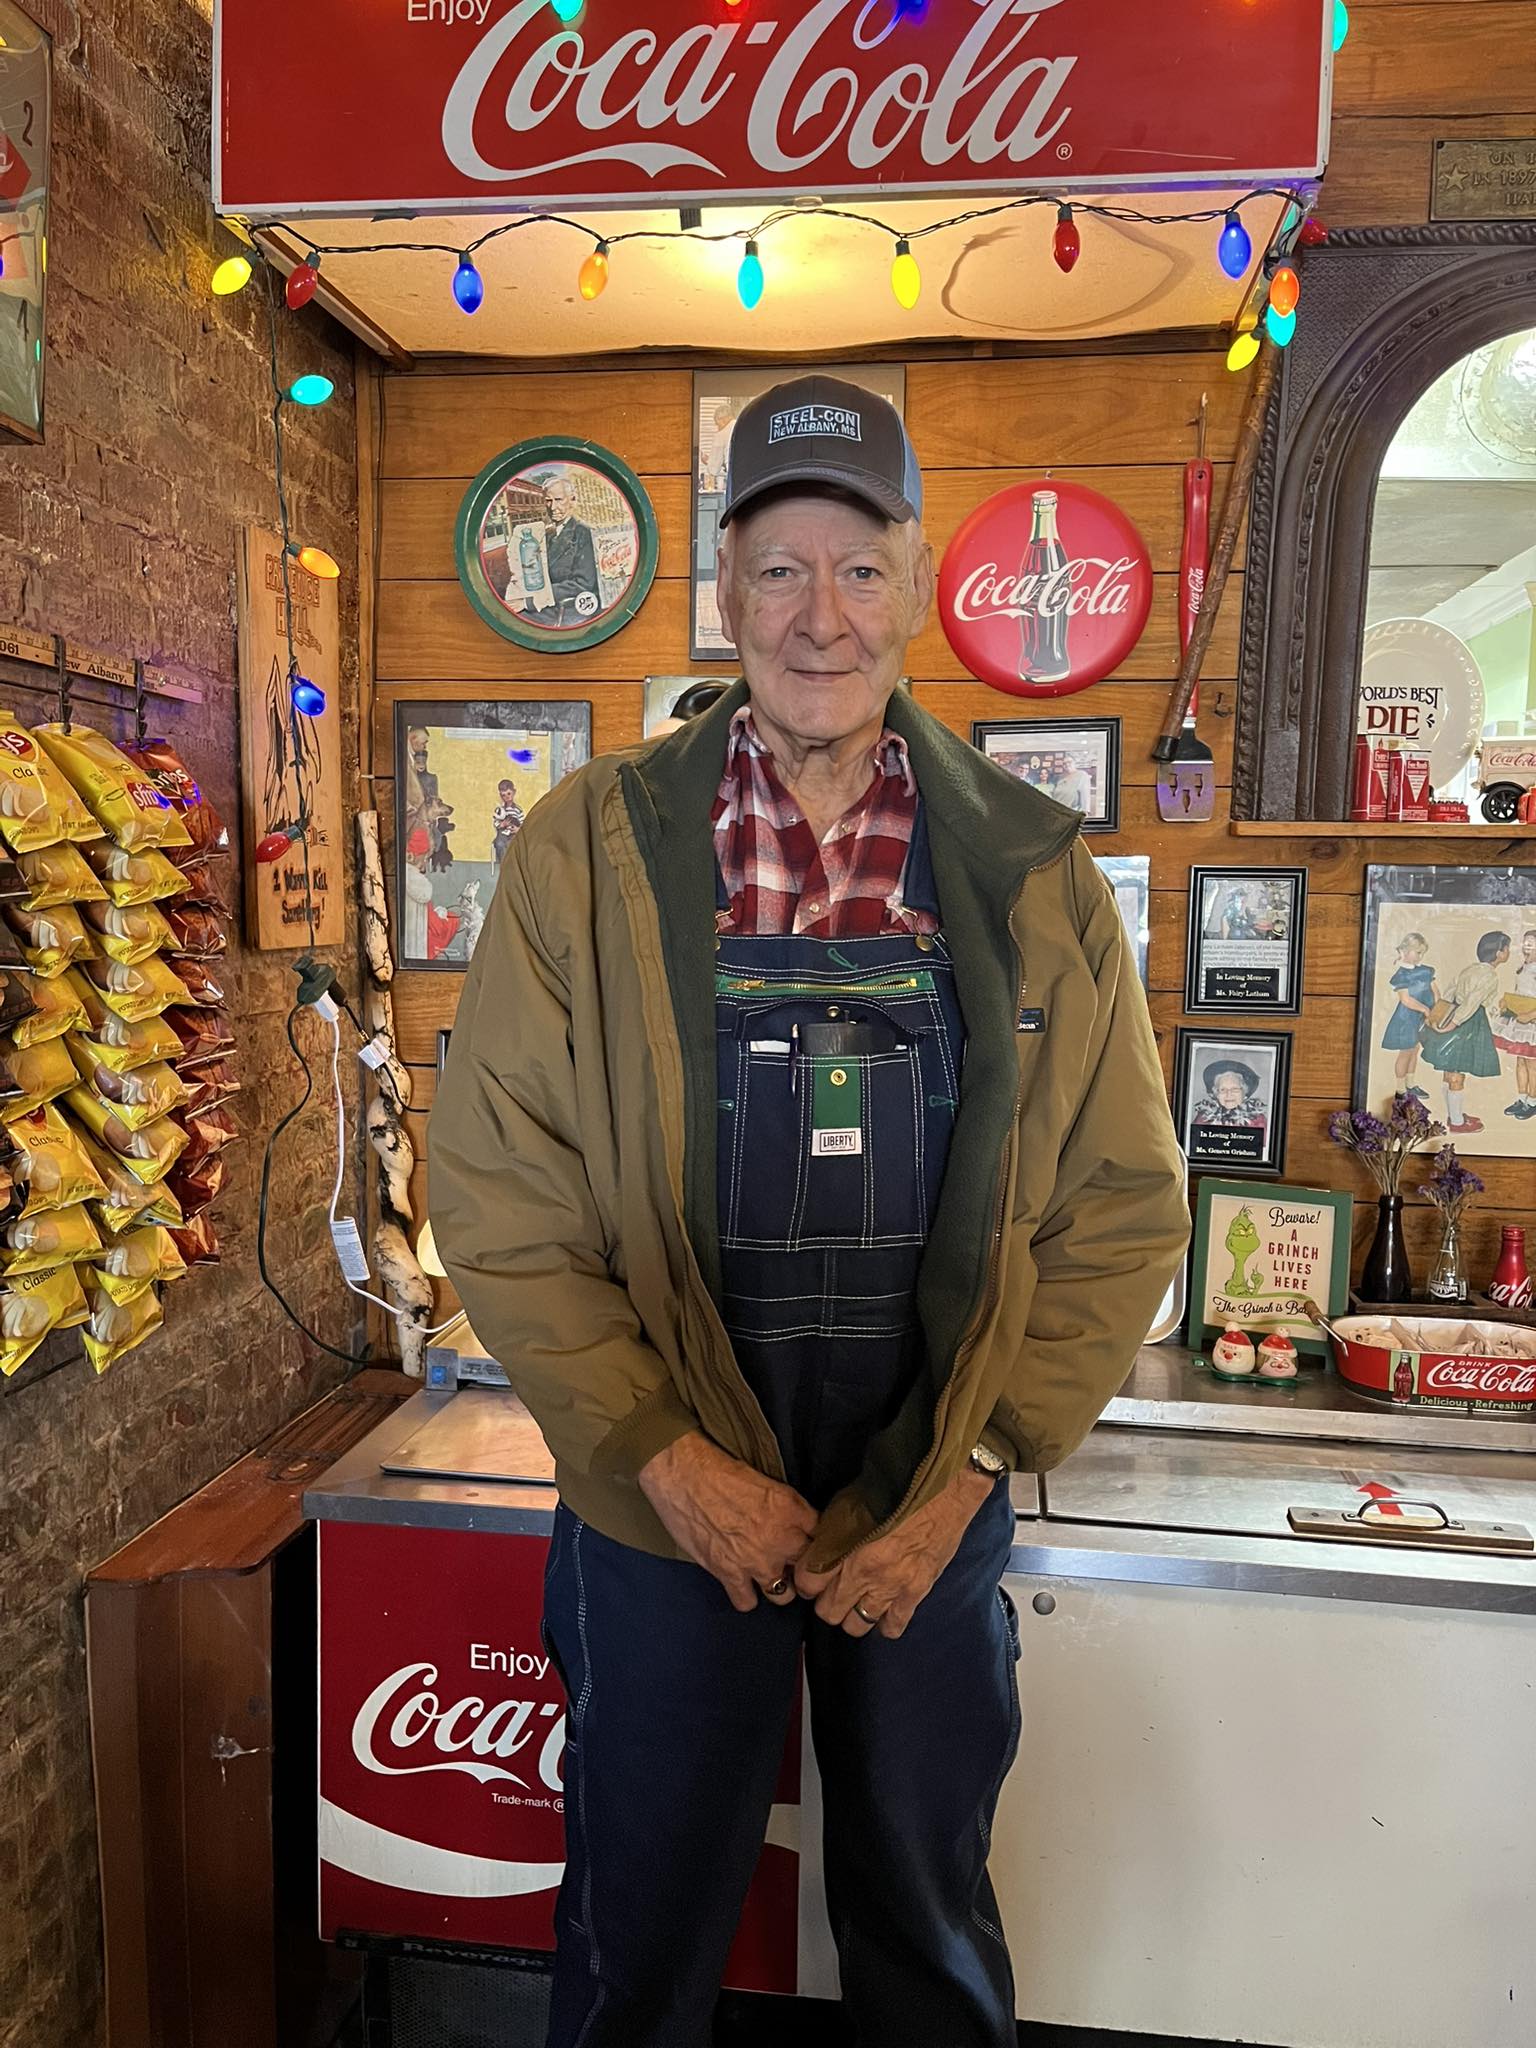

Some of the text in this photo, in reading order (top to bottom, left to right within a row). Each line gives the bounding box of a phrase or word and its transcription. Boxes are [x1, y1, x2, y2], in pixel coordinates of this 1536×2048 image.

[407, 0, 492, 25] Enjoy
[442, 0, 1073, 182] Coca-Cola
[773, 407, 857, 429] STEEL-CON
[773, 424, 796, 438] NEW
[841, 424, 856, 437] MS
[953, 556, 1140, 622] Coca-Cola
[1410, 687, 1443, 709] BEST
[151, 769, 189, 788] oritos
[1224, 973, 1246, 981] Loving
[1246, 974, 1272, 982] Memory
[823, 1134, 853, 1147] LIBERTY
[1208, 1131, 1230, 1139] Loving
[1230, 1132, 1255, 1141] Memory
[1268, 1206, 1321, 1227] Beware!
[1290, 1229, 1298, 1241] A
[1268, 1242, 1319, 1260] GRINCH
[1273, 1260, 1312, 1275] LIVES
[1274, 1276, 1308, 1290] HERE
[1212, 1296, 1236, 1313] The
[1237, 1302, 1273, 1317] Grinch
[1275, 1303, 1283, 1312] is
[1426, 1360, 1536, 1393] Coca-Cola
[1420, 1396, 1468, 1407] Delicious
[1475, 1400, 1534, 1411] Refreshing
[470, 1643, 550, 1680] Enjoy
[352, 1662, 567, 1793] Coca-
[491, 1792, 551, 1809] Trade-mark
